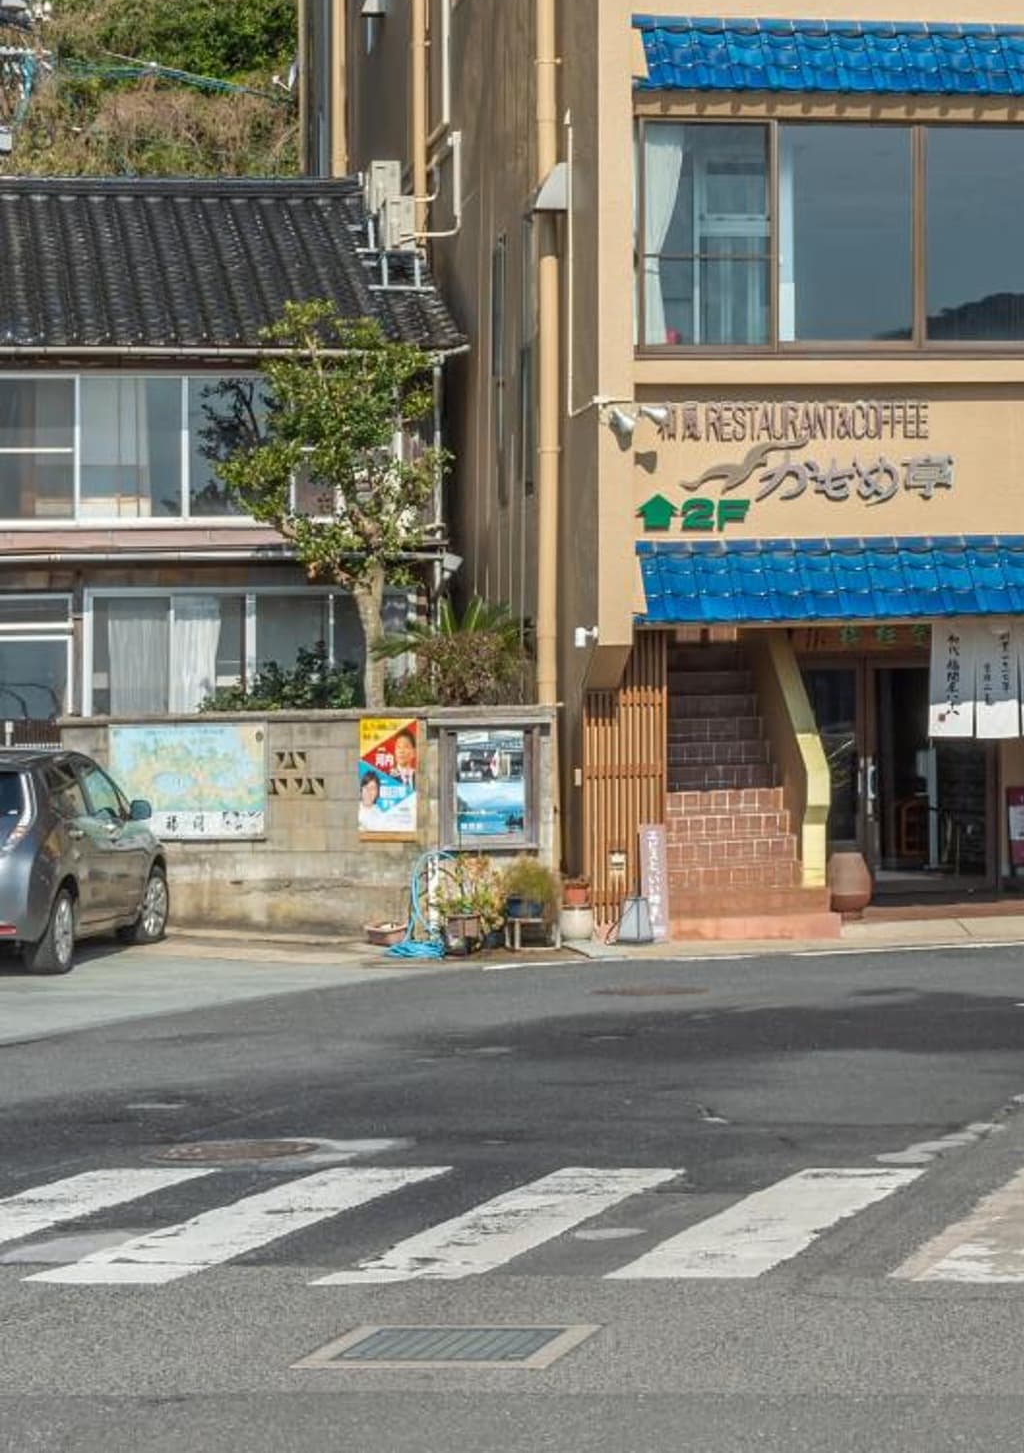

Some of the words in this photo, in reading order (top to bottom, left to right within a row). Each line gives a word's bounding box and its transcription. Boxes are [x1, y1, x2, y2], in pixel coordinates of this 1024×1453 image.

[705, 401, 929, 442] RESTAURANT&COFFEE
[755, 454, 955, 506] かもめ亭
[680, 499, 750, 531] 2F
